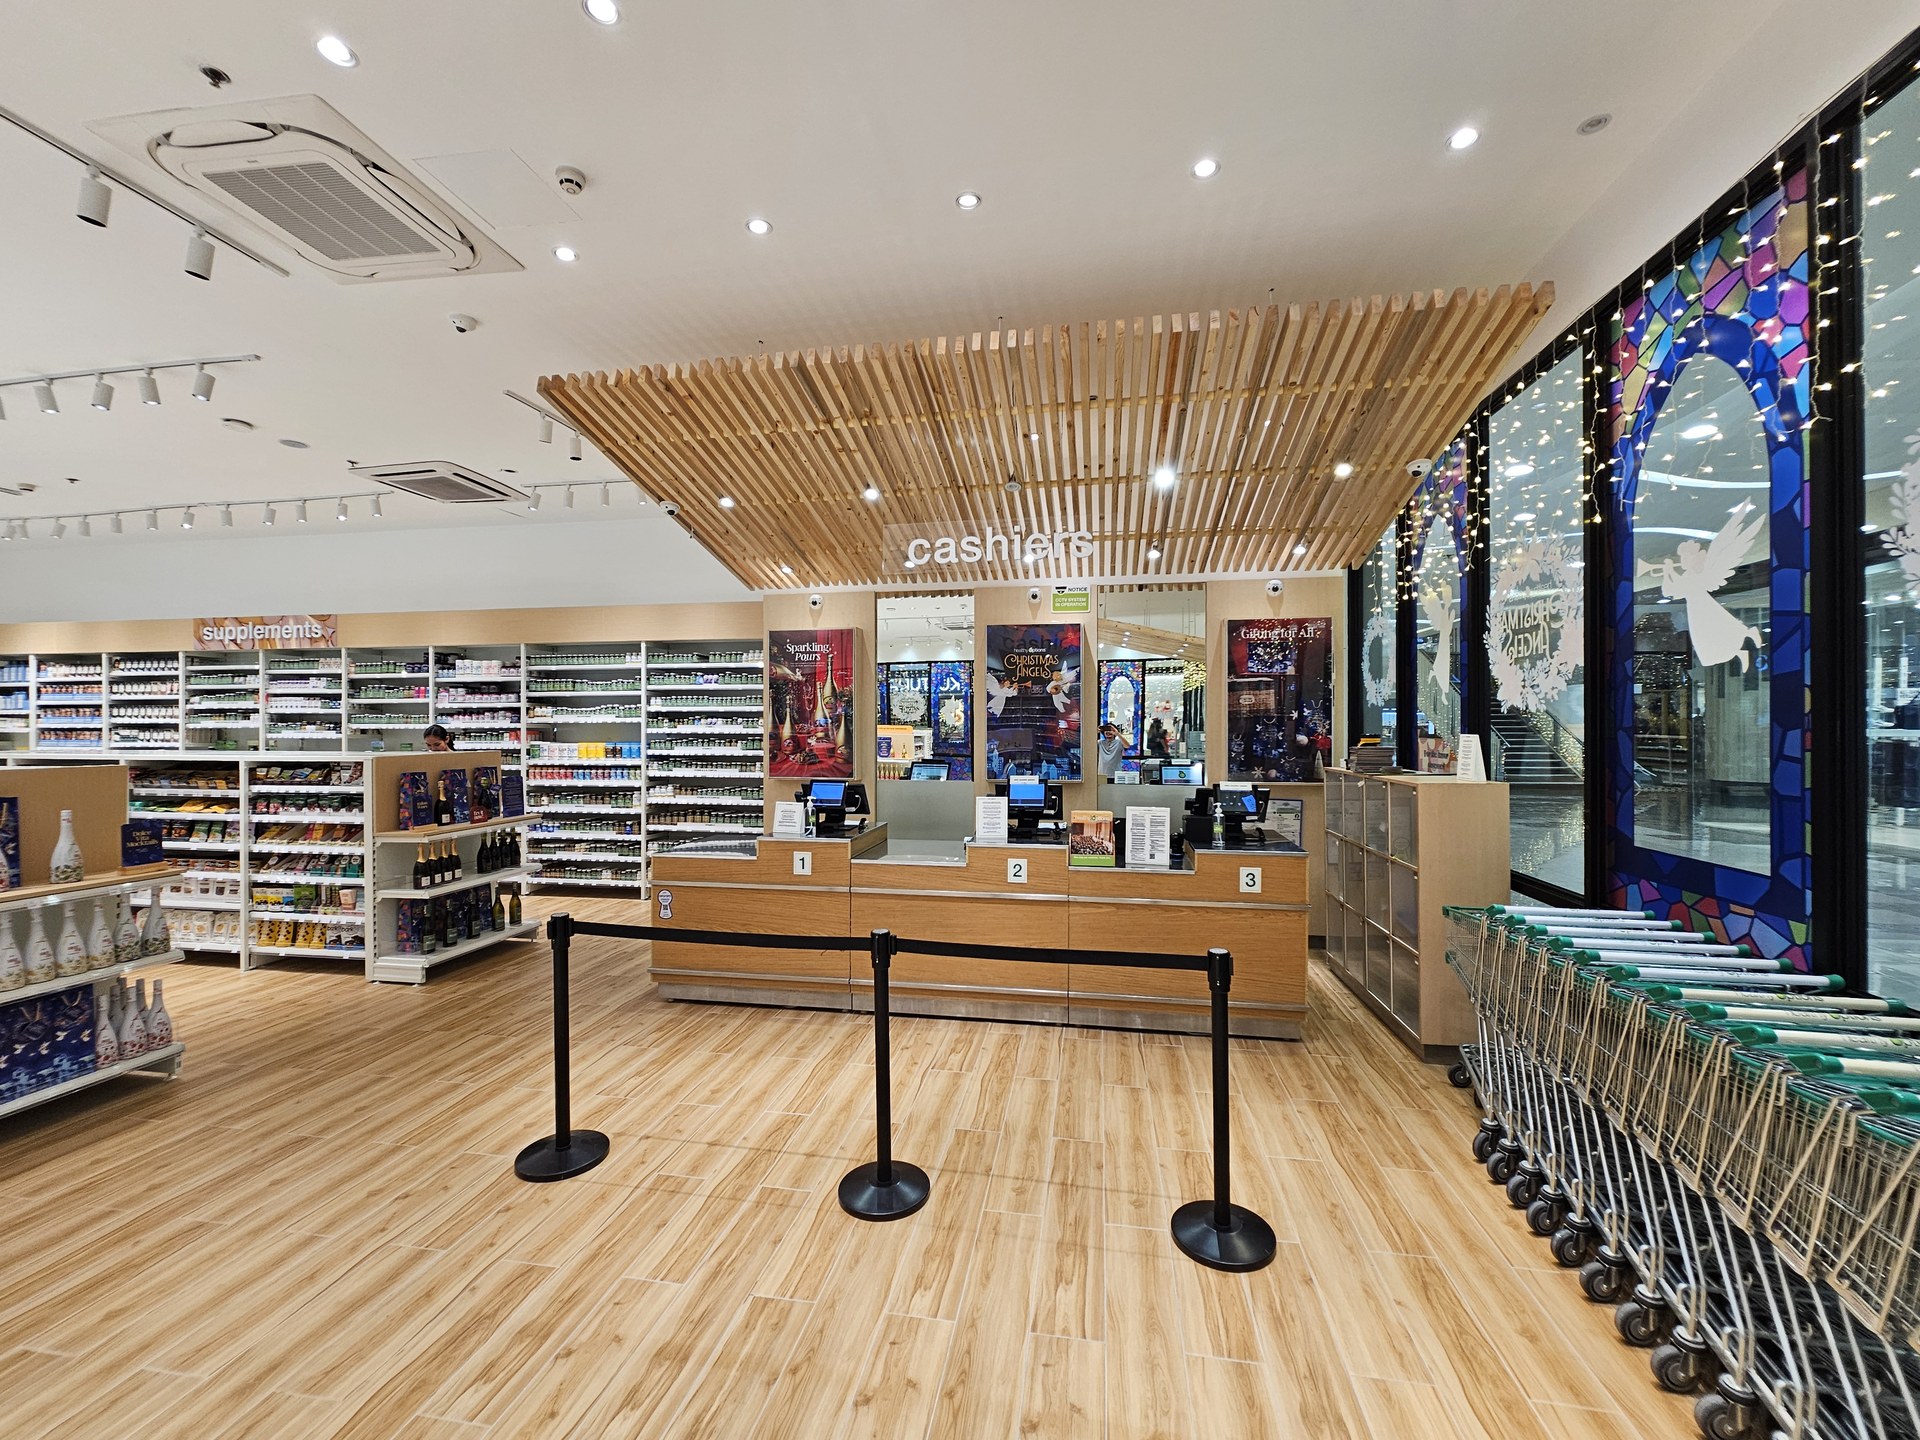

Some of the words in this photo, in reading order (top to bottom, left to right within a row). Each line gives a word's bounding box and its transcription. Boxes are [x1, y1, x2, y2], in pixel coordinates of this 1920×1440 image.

[908, 525, 1094, 564] cashiers
[203, 621, 322, 644] supplements
[1281, 627, 1297, 638] for
[1298, 627, 1314, 638] All
[786, 642, 830, 654] Sparkling
[795, 653, 821, 661] Pours
[1004, 653, 1059, 669] CHRISTMAS
[1012, 663, 1051, 681] ANGELS
[799, 857, 805, 870] 1
[1013, 864, 1022, 877] 2
[1245, 872, 1256, 887] 3
